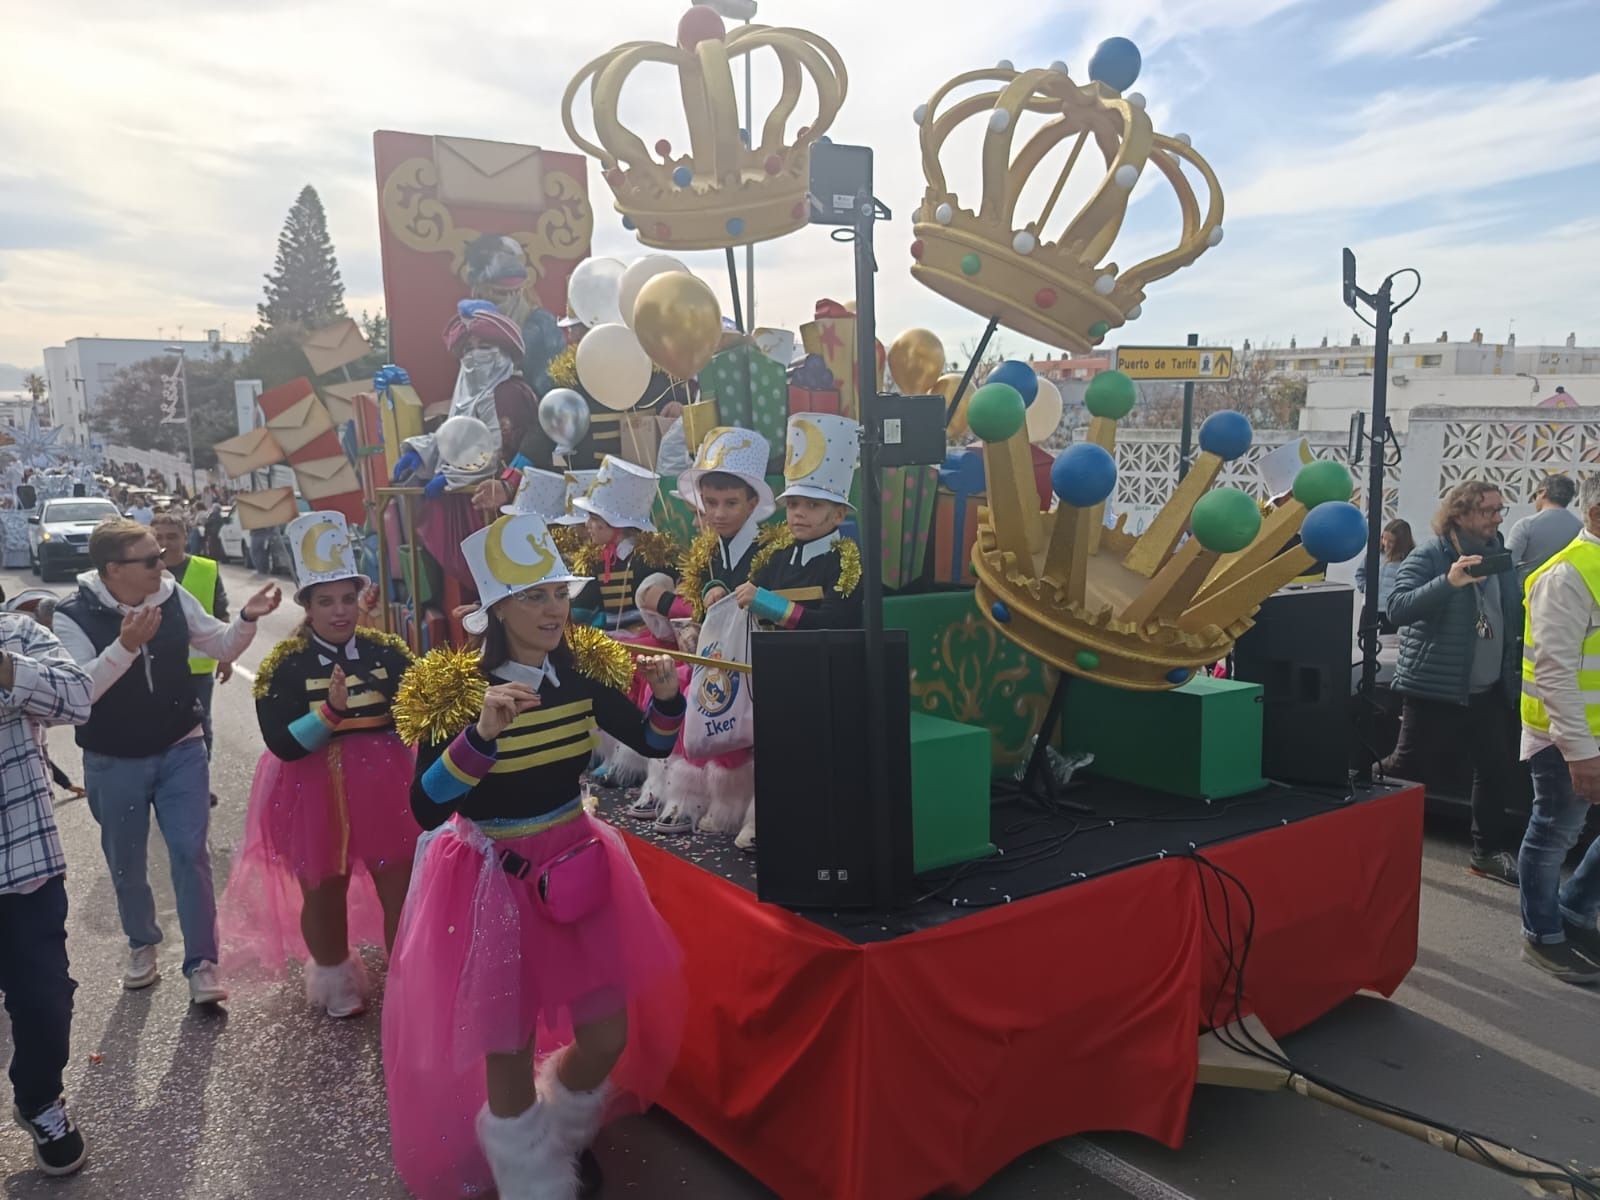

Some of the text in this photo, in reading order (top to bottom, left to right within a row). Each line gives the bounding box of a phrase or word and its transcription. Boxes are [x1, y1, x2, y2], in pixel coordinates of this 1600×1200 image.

[1118, 358, 1197, 369] Puerto de Tarifa
[704, 716, 736, 737] Iker
